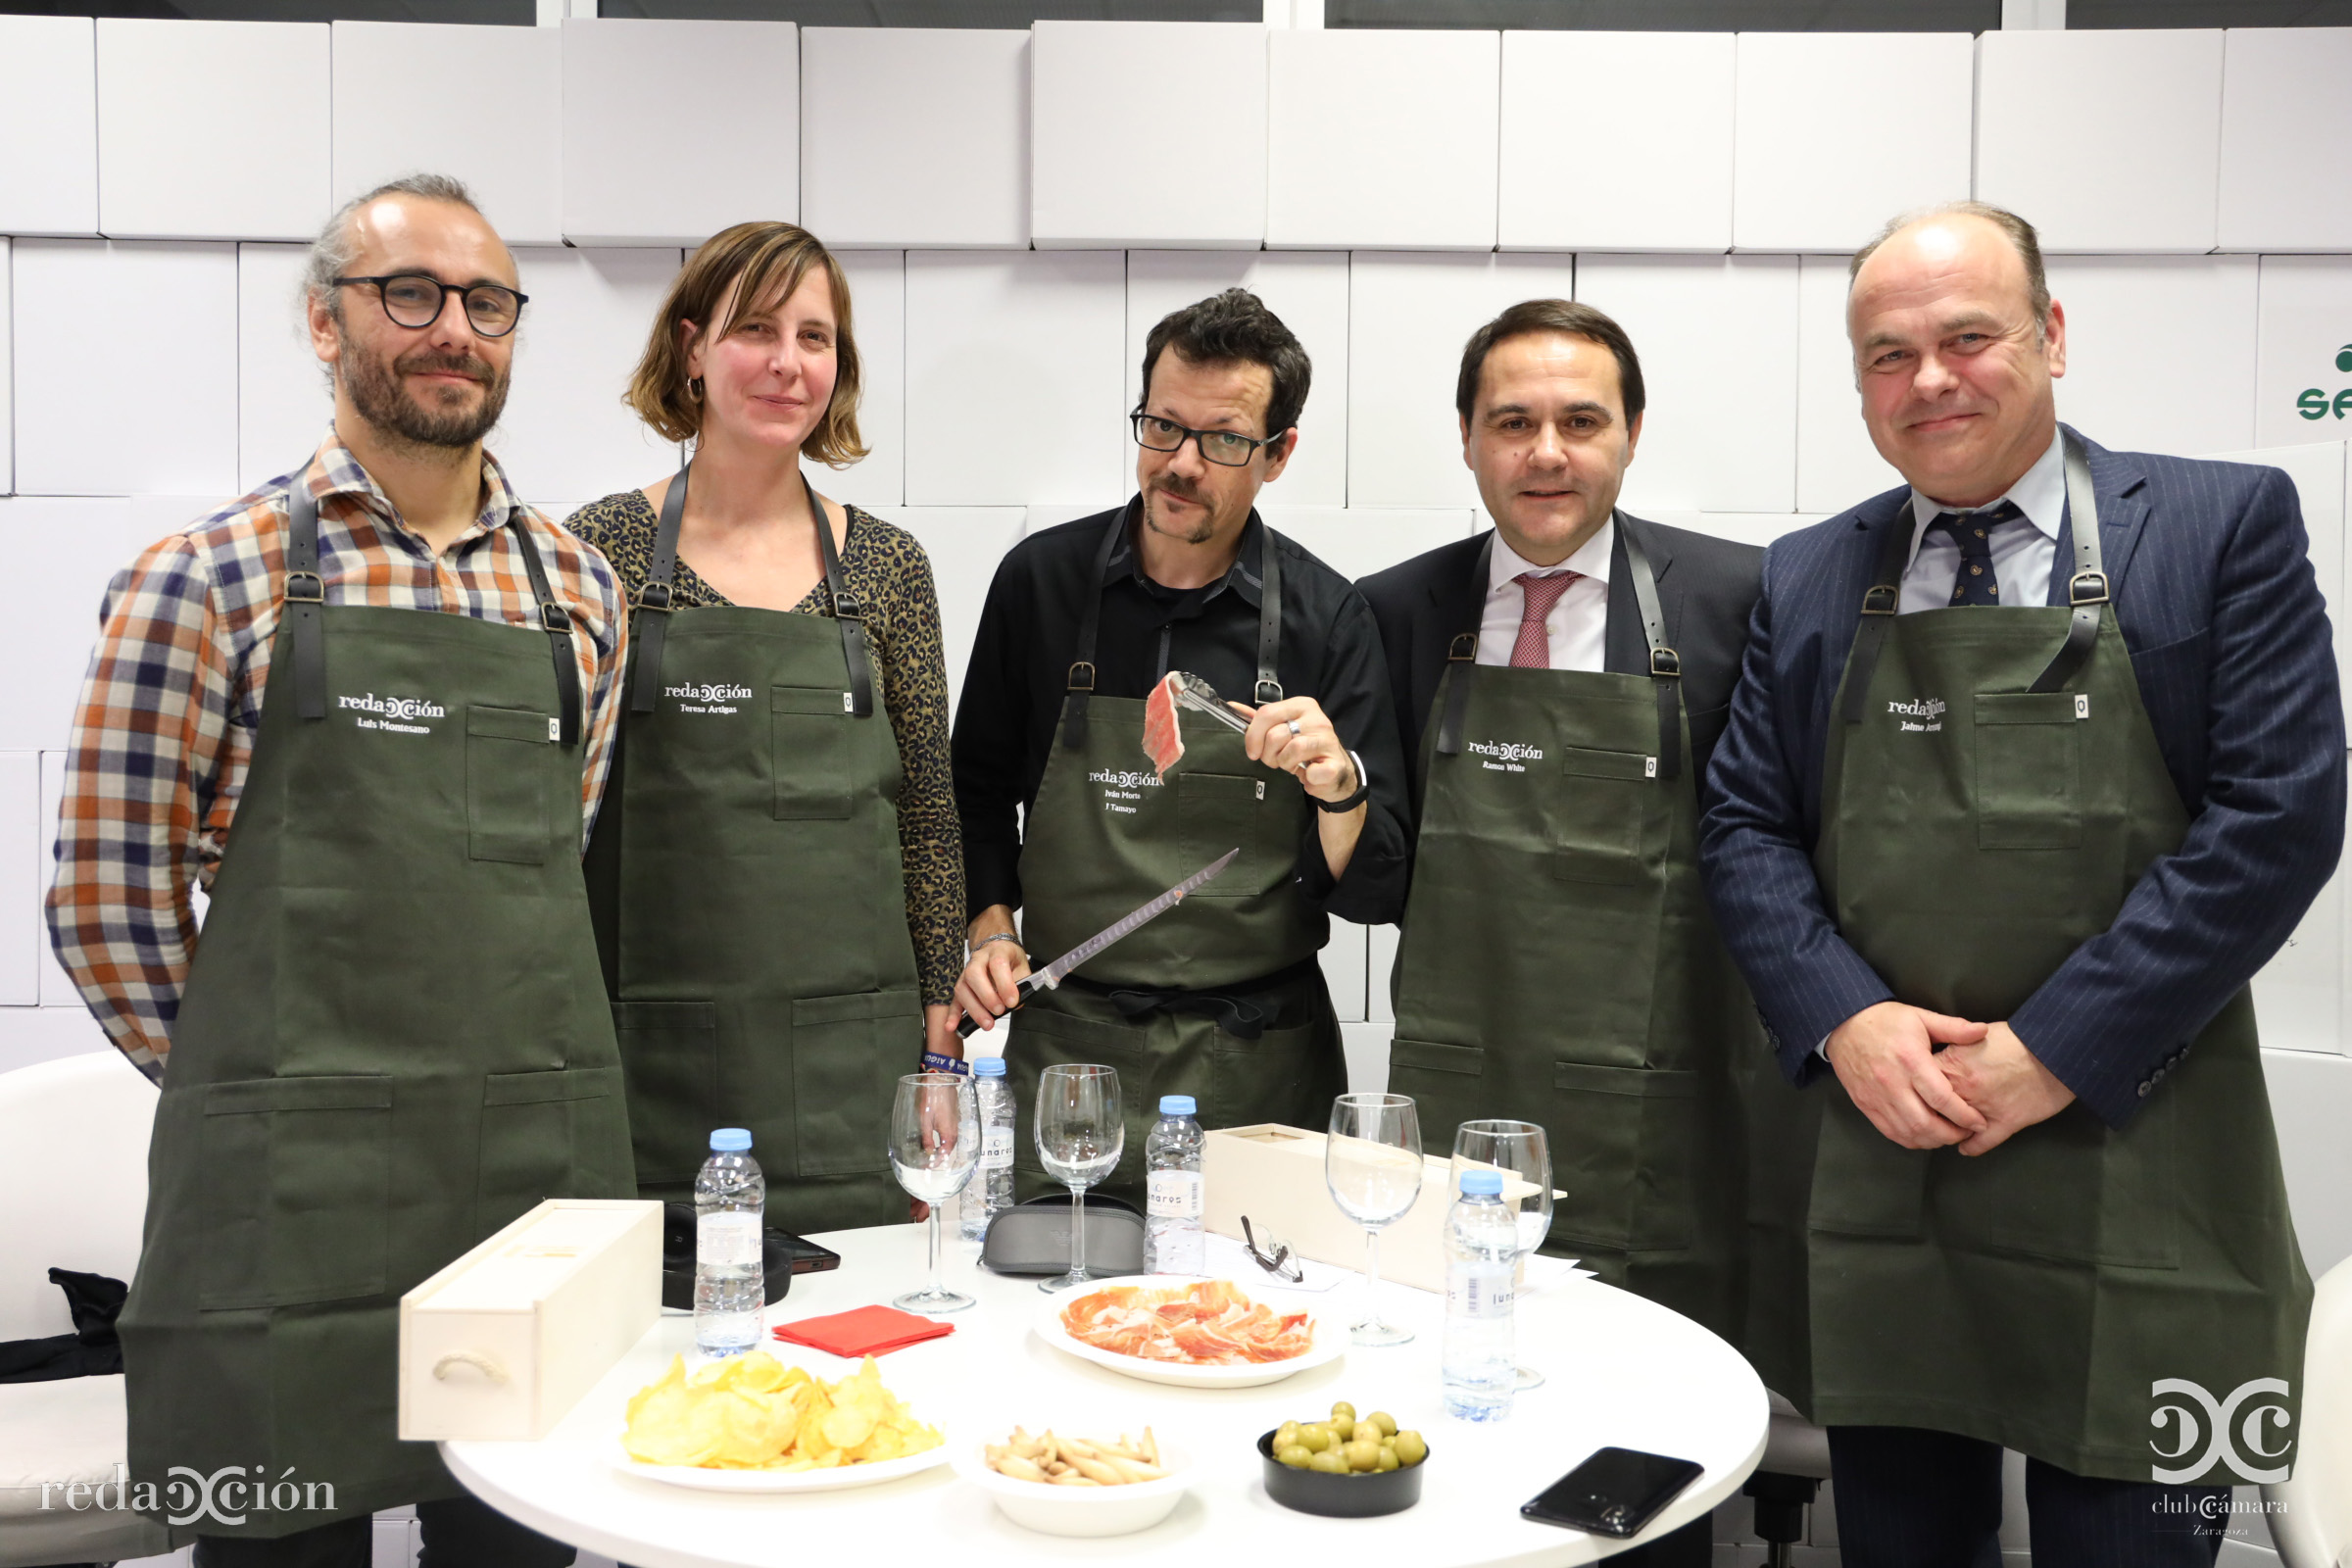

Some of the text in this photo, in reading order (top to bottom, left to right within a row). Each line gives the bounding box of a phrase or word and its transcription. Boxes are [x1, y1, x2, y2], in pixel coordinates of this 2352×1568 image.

[663, 681, 753, 703] redacción
[338, 692, 446, 720] redacción
[680, 704, 737, 714] Teresa Artigas
[358, 716, 430, 734] Luis Montesano
[1900, 720, 1925, 732] Jaime
[1467, 740, 1544, 761] redacción
[1506, 762, 1526, 772] White
[1104, 789, 1142, 800] Iván Morte
[1110, 804, 1137, 814] Tamayo
